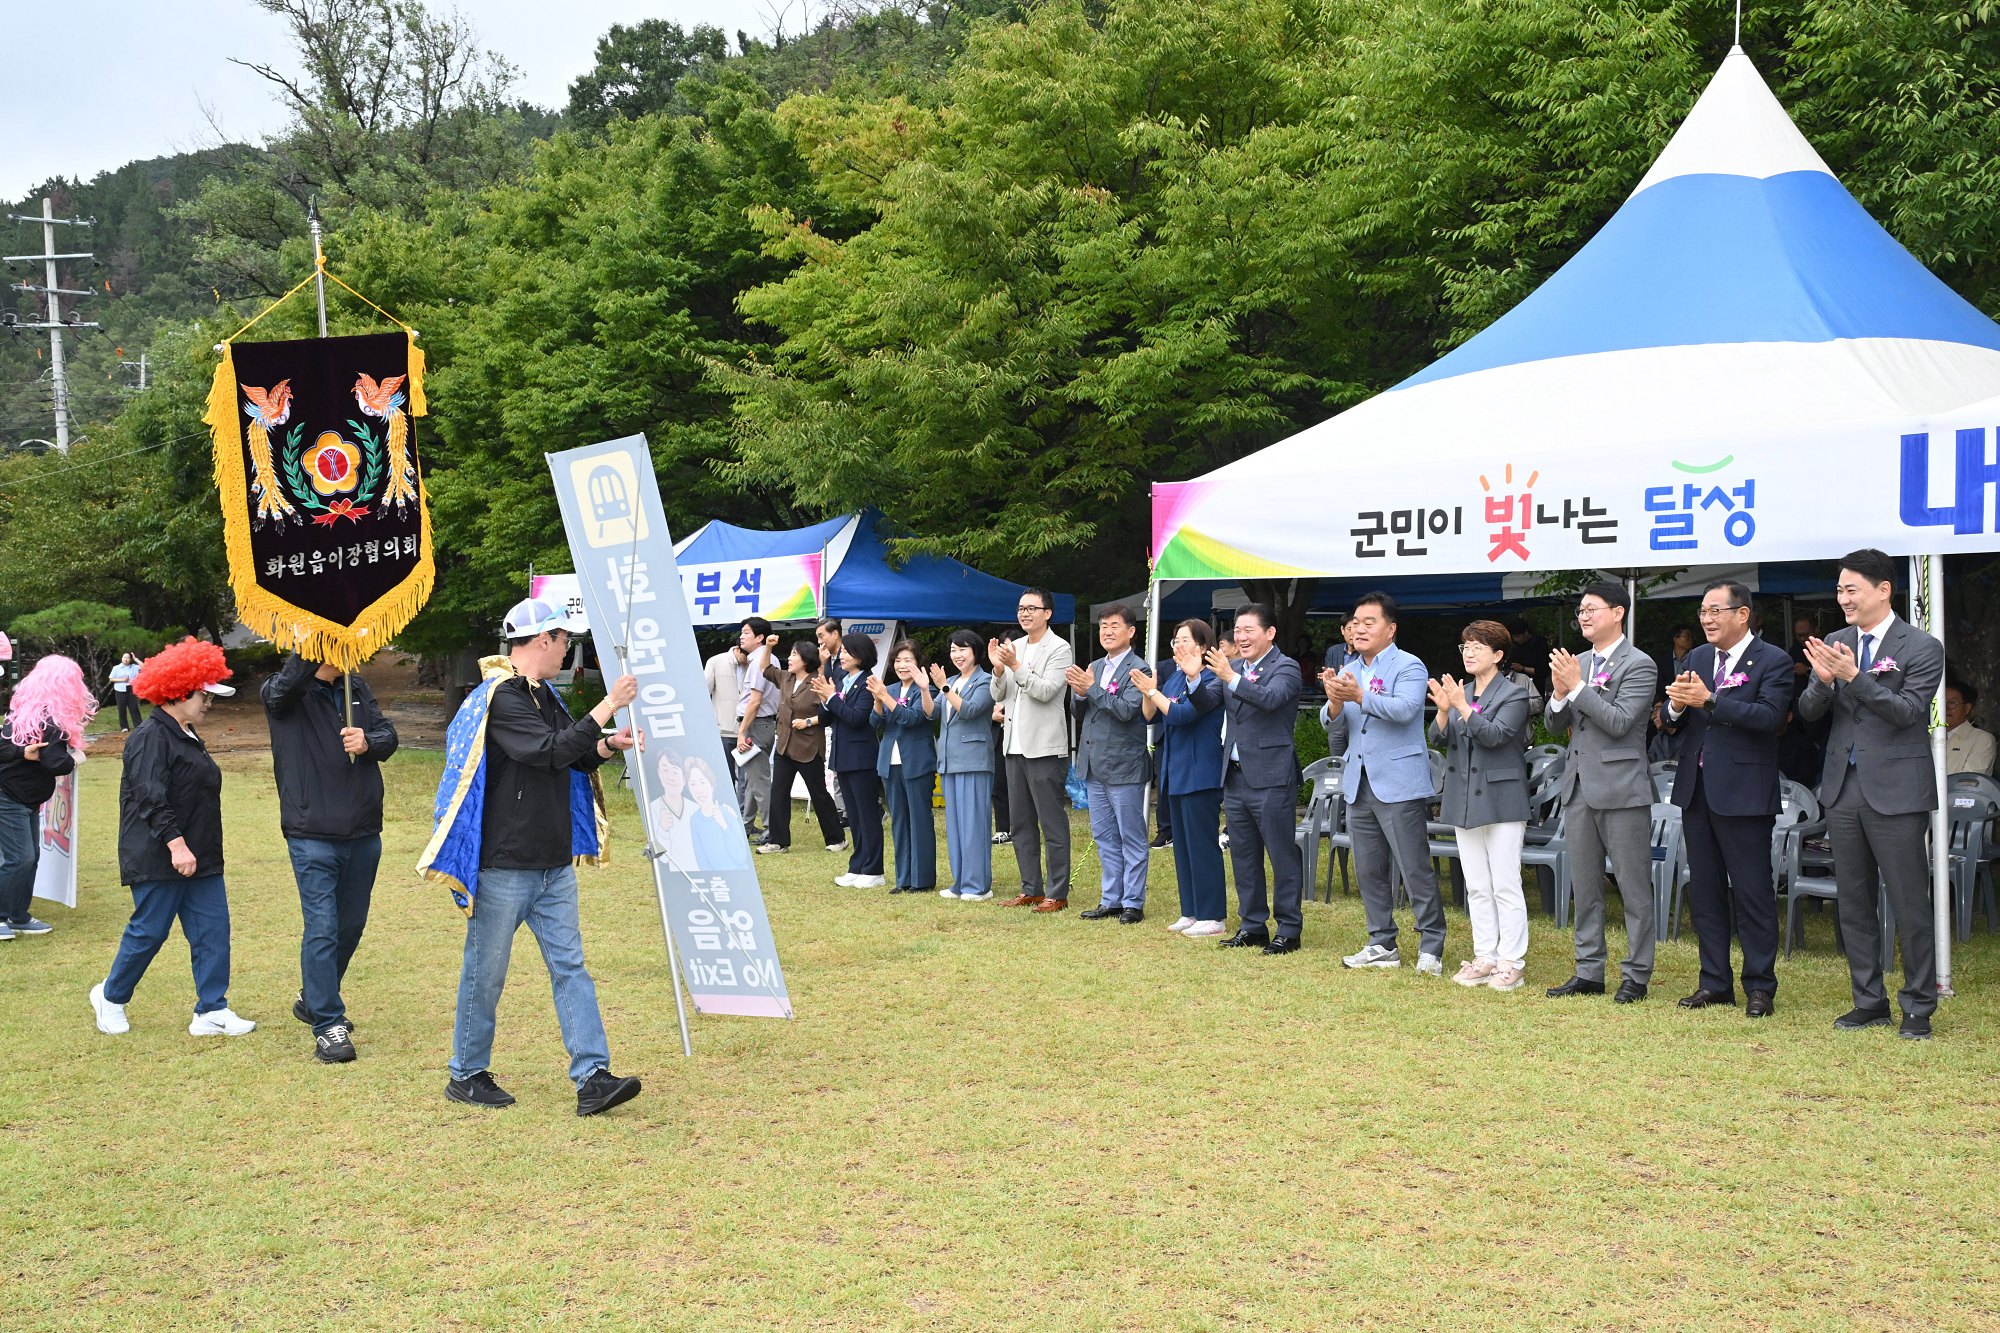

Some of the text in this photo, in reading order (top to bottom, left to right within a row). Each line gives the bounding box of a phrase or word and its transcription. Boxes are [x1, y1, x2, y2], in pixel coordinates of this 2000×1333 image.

[1350, 479, 1756, 563] 군민이 빛나는 달성
[264, 533, 418, 579] 화원읍이장협의회
[680, 567, 762, 616] 부석
